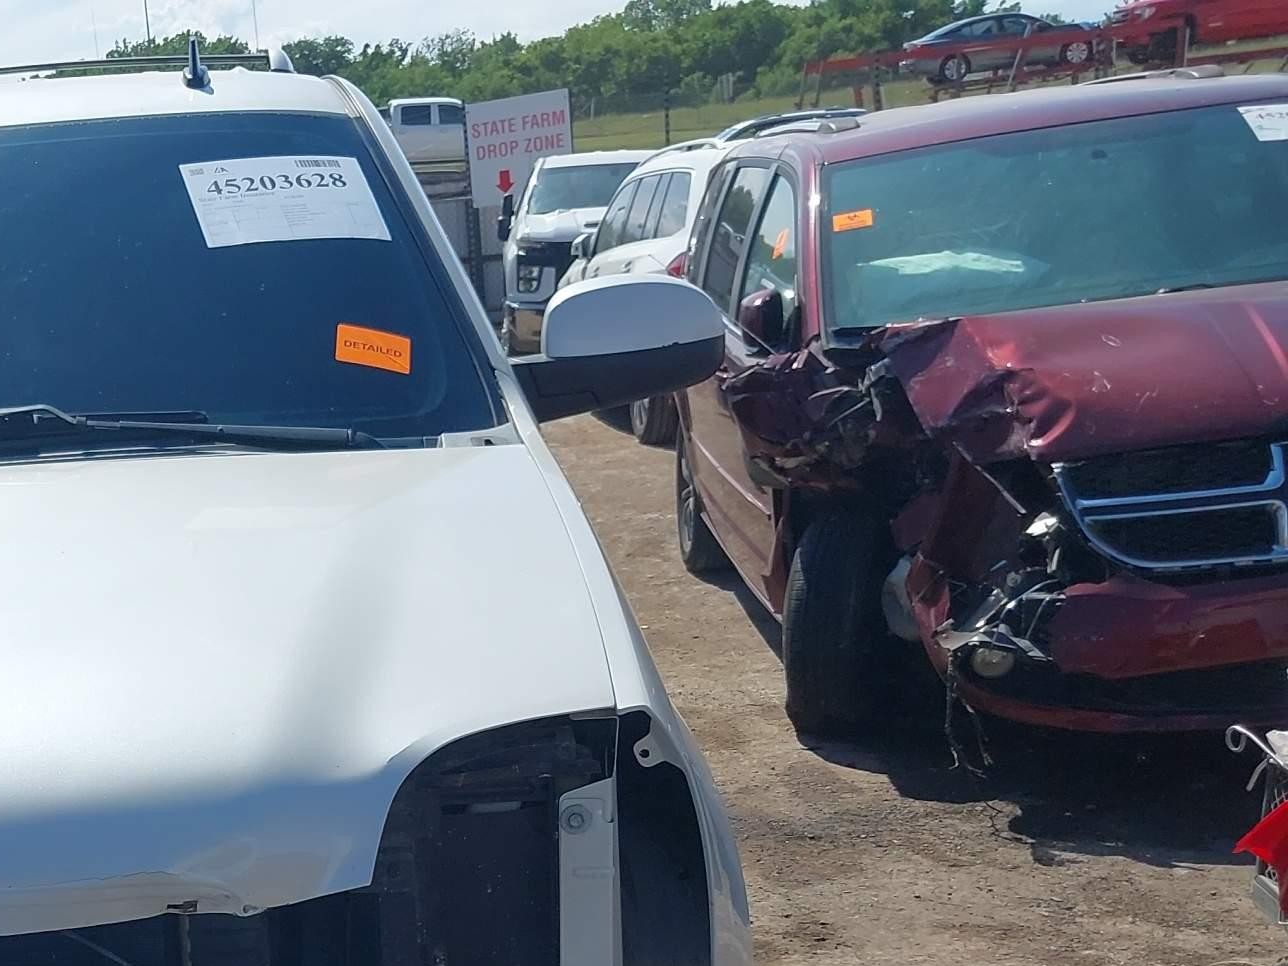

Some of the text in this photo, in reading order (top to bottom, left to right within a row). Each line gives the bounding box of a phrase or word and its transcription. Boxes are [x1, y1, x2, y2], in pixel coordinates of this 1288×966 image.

[472, 110, 566, 139] STATE FARM
[476, 133, 565, 160] DROP ZONE
[207, 172, 347, 195] 45203628
[344, 340, 402, 358] DETAILED
